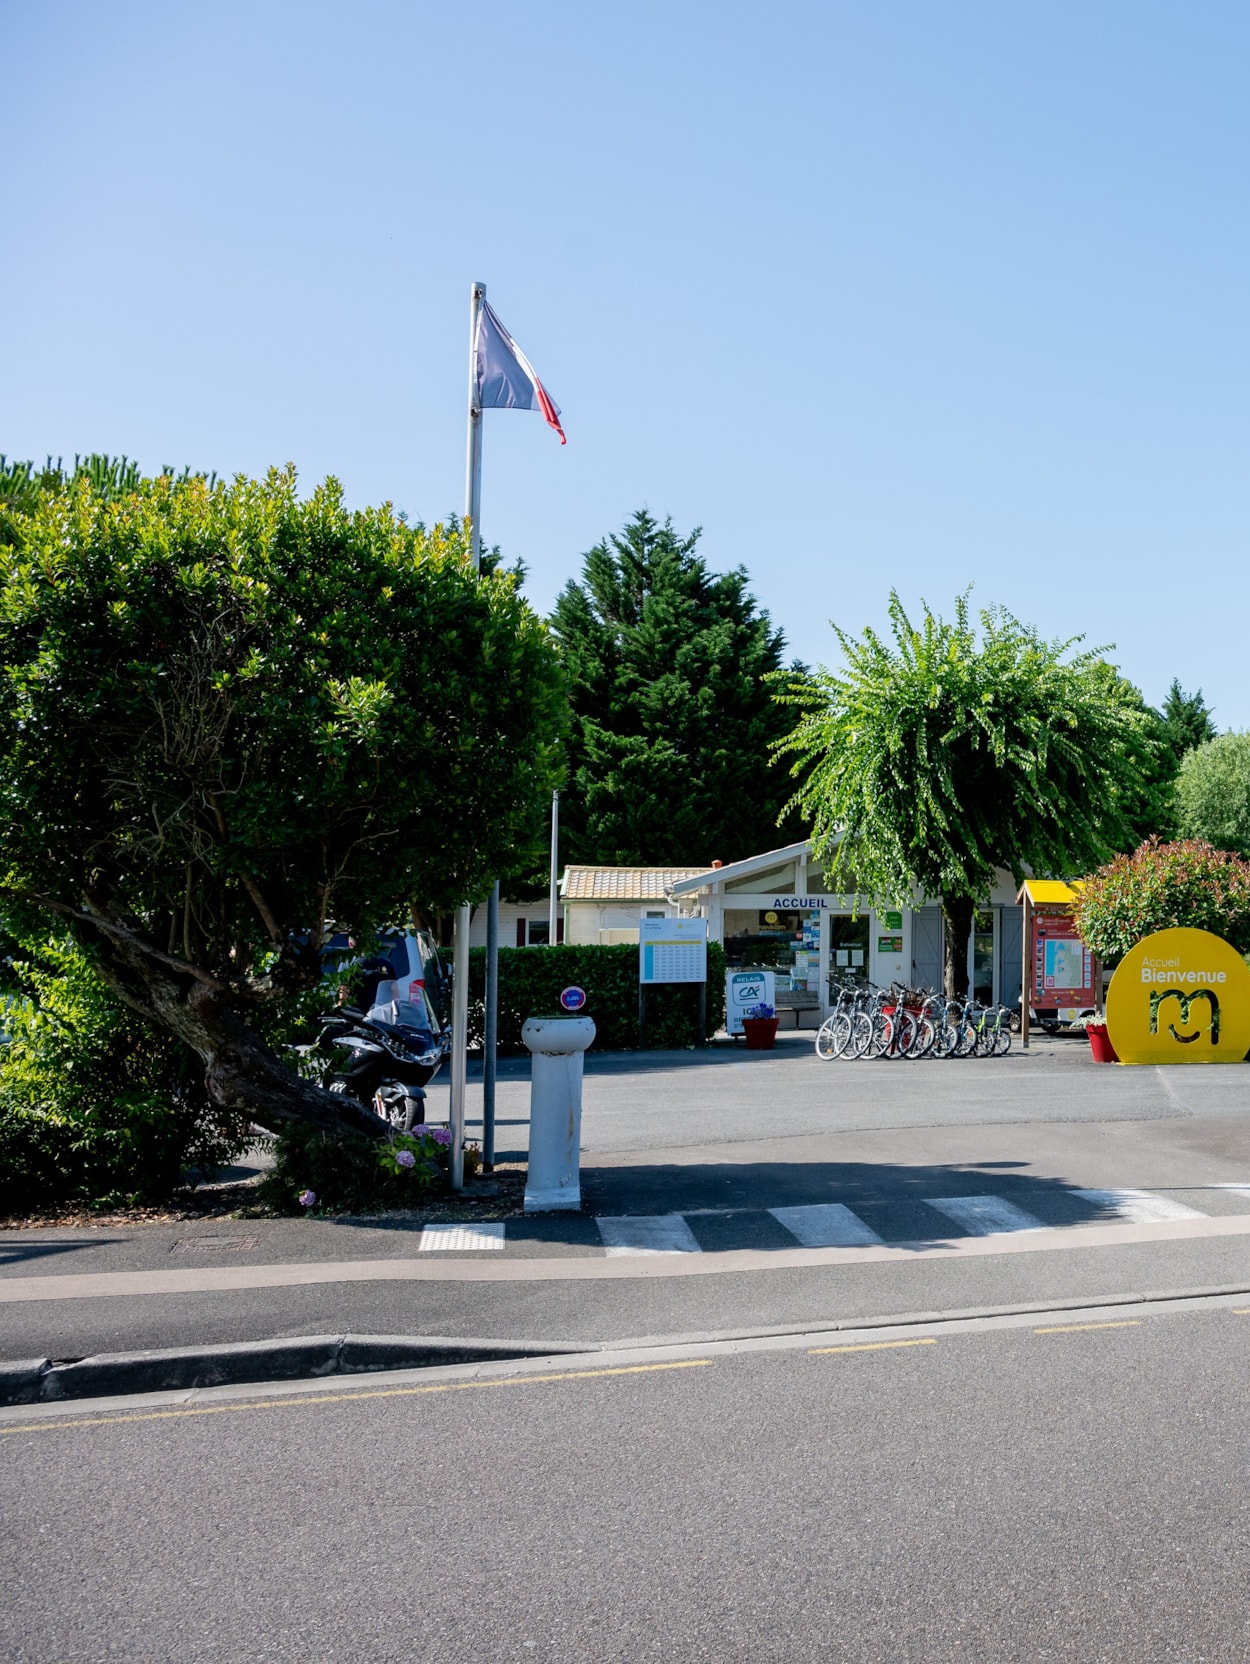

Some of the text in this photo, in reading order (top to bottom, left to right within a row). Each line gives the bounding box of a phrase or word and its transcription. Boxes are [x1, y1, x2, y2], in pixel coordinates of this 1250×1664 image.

[773, 898, 828, 908] ACCUEIL
[1141, 956, 1180, 967] Accueil
[736, 975, 761, 983] RELAIS
[1141, 968, 1227, 983] Bienvenue
